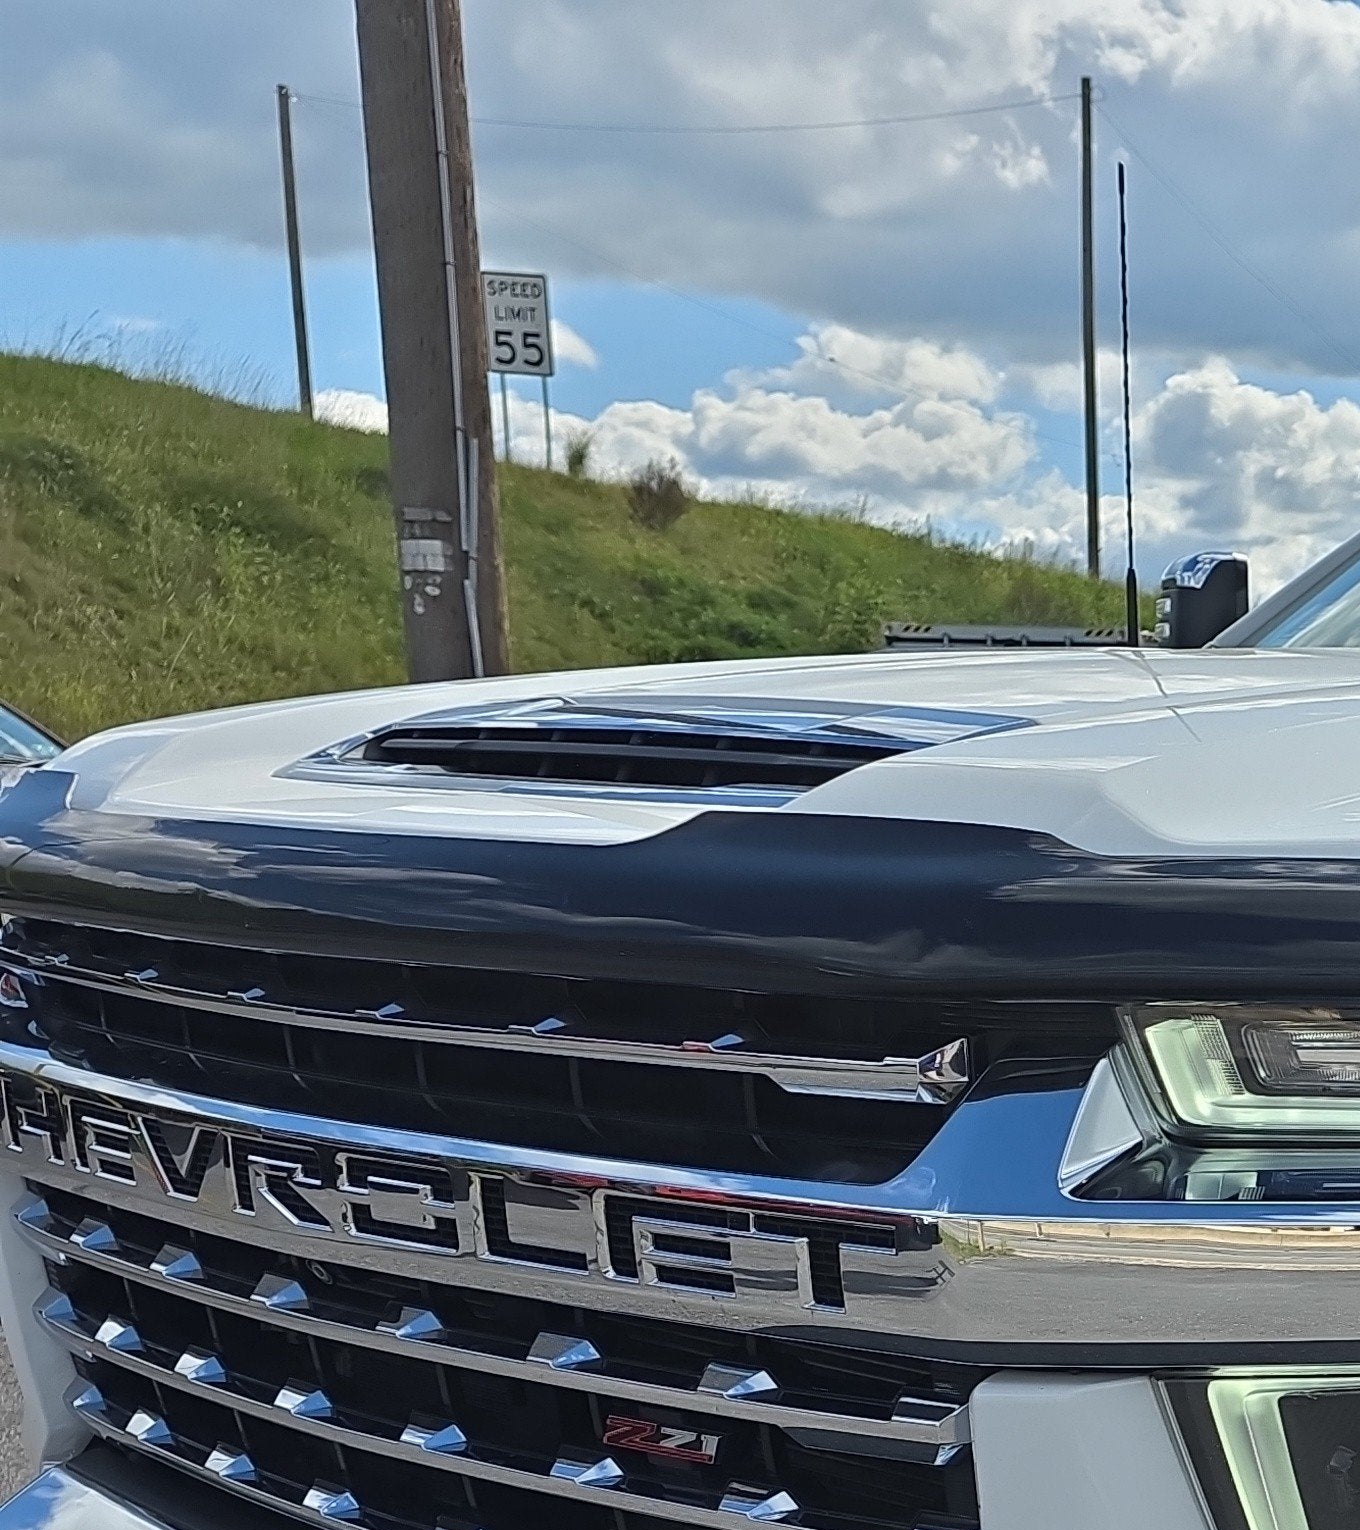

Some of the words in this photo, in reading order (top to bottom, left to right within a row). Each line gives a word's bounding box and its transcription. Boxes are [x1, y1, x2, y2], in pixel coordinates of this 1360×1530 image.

[486, 279, 542, 299] SPEED
[493, 306, 537, 323] LIMIT
[494, 330, 544, 367] 55
[0, 1073, 897, 1314] HEVROLET
[602, 1414, 720, 1465] Z71
